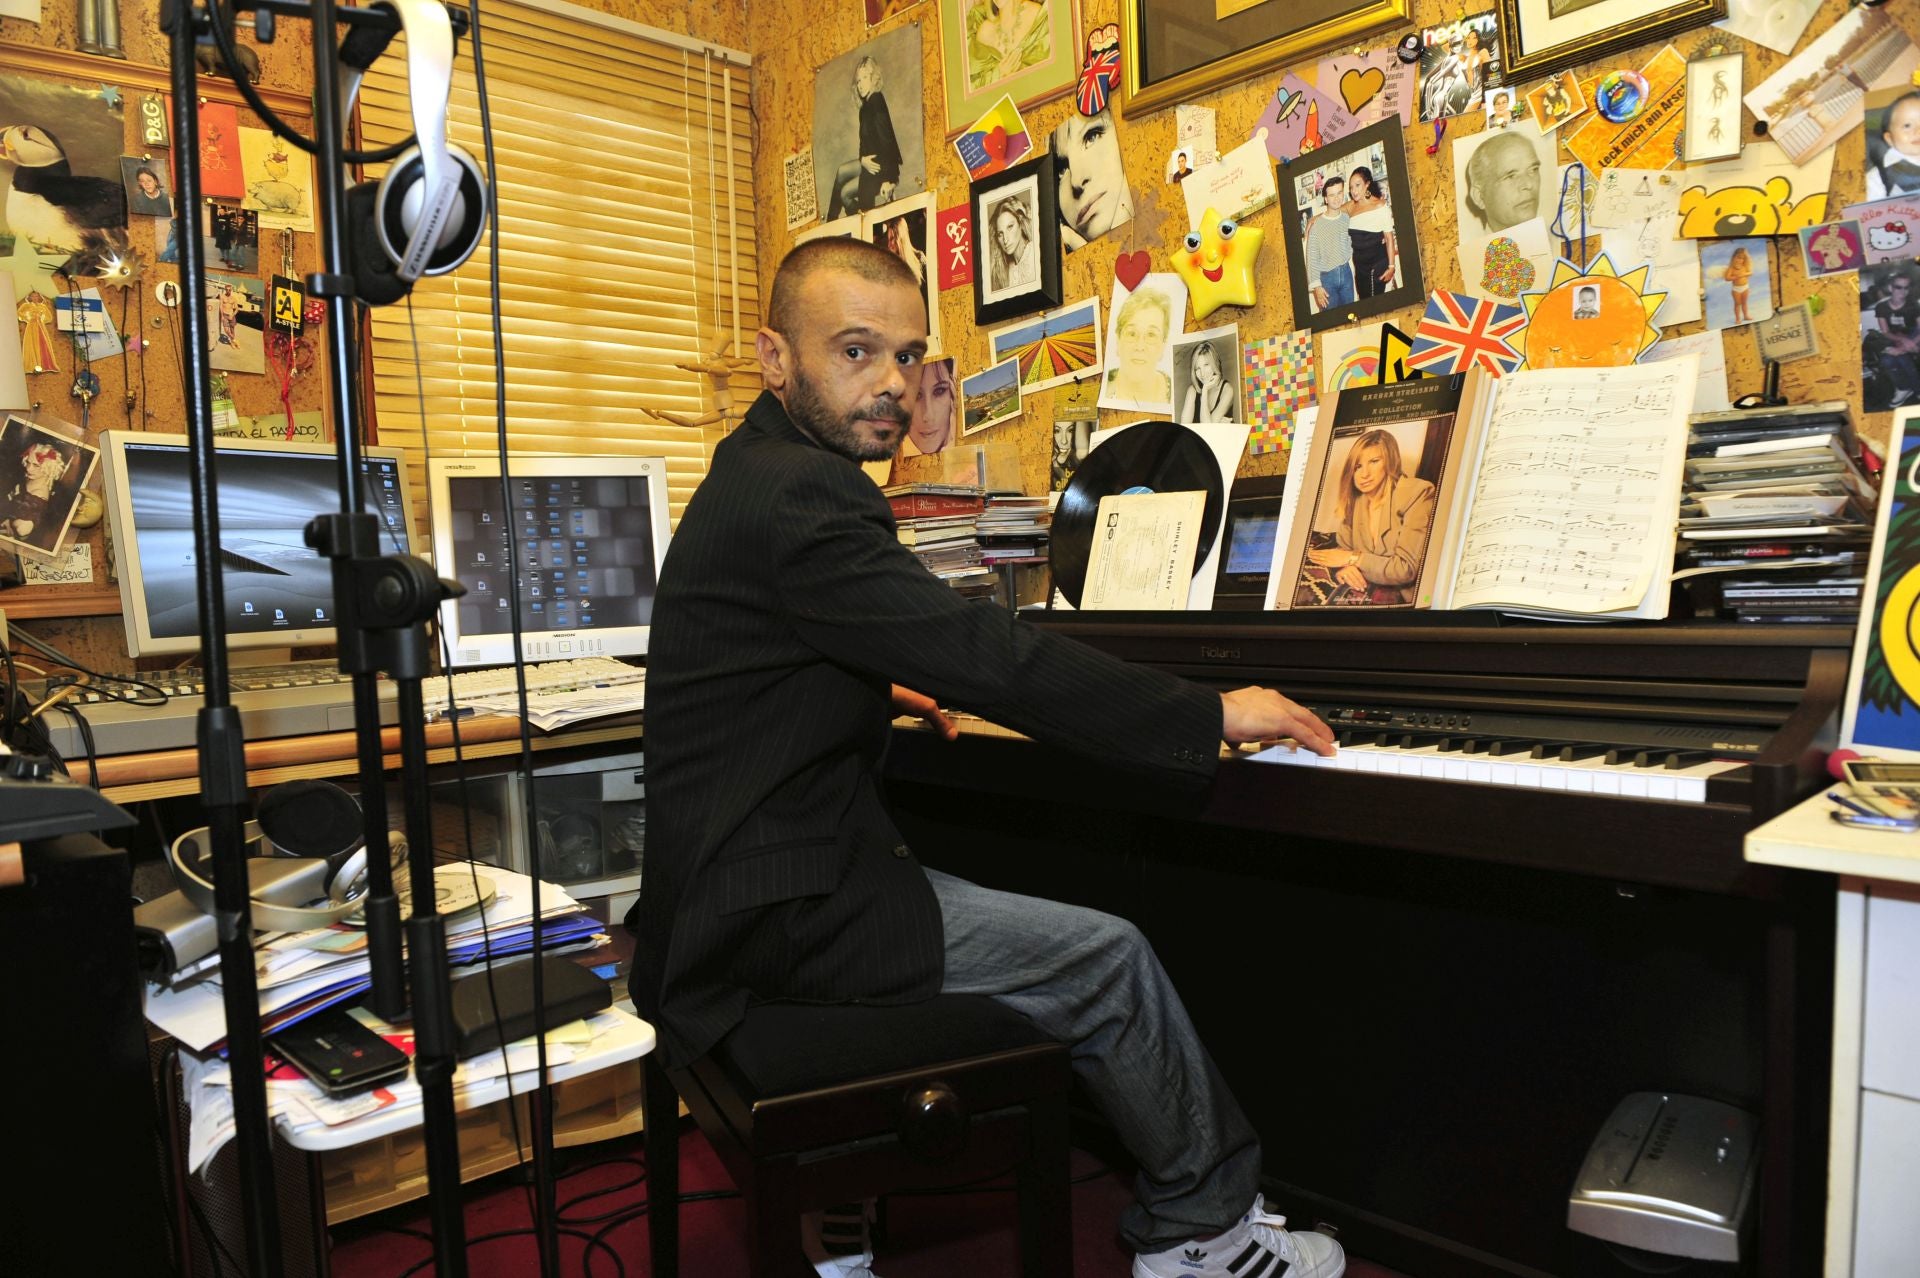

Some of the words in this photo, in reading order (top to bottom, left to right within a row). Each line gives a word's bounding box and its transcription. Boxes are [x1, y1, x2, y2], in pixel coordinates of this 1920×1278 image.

[142, 102, 163, 141] D&G
[1598, 145, 1623, 168] Leck
[1621, 122, 1647, 149] mich
[1645, 109, 1664, 127] am
[1660, 84, 1685, 112] Arsc
[1860, 209, 1883, 224] ello
[1765, 328, 1803, 345] VERSACE
[1378, 403, 1422, 414] COLLECTION
[251, 429, 267, 439] EL
[1201, 646, 1241, 659] Roland
